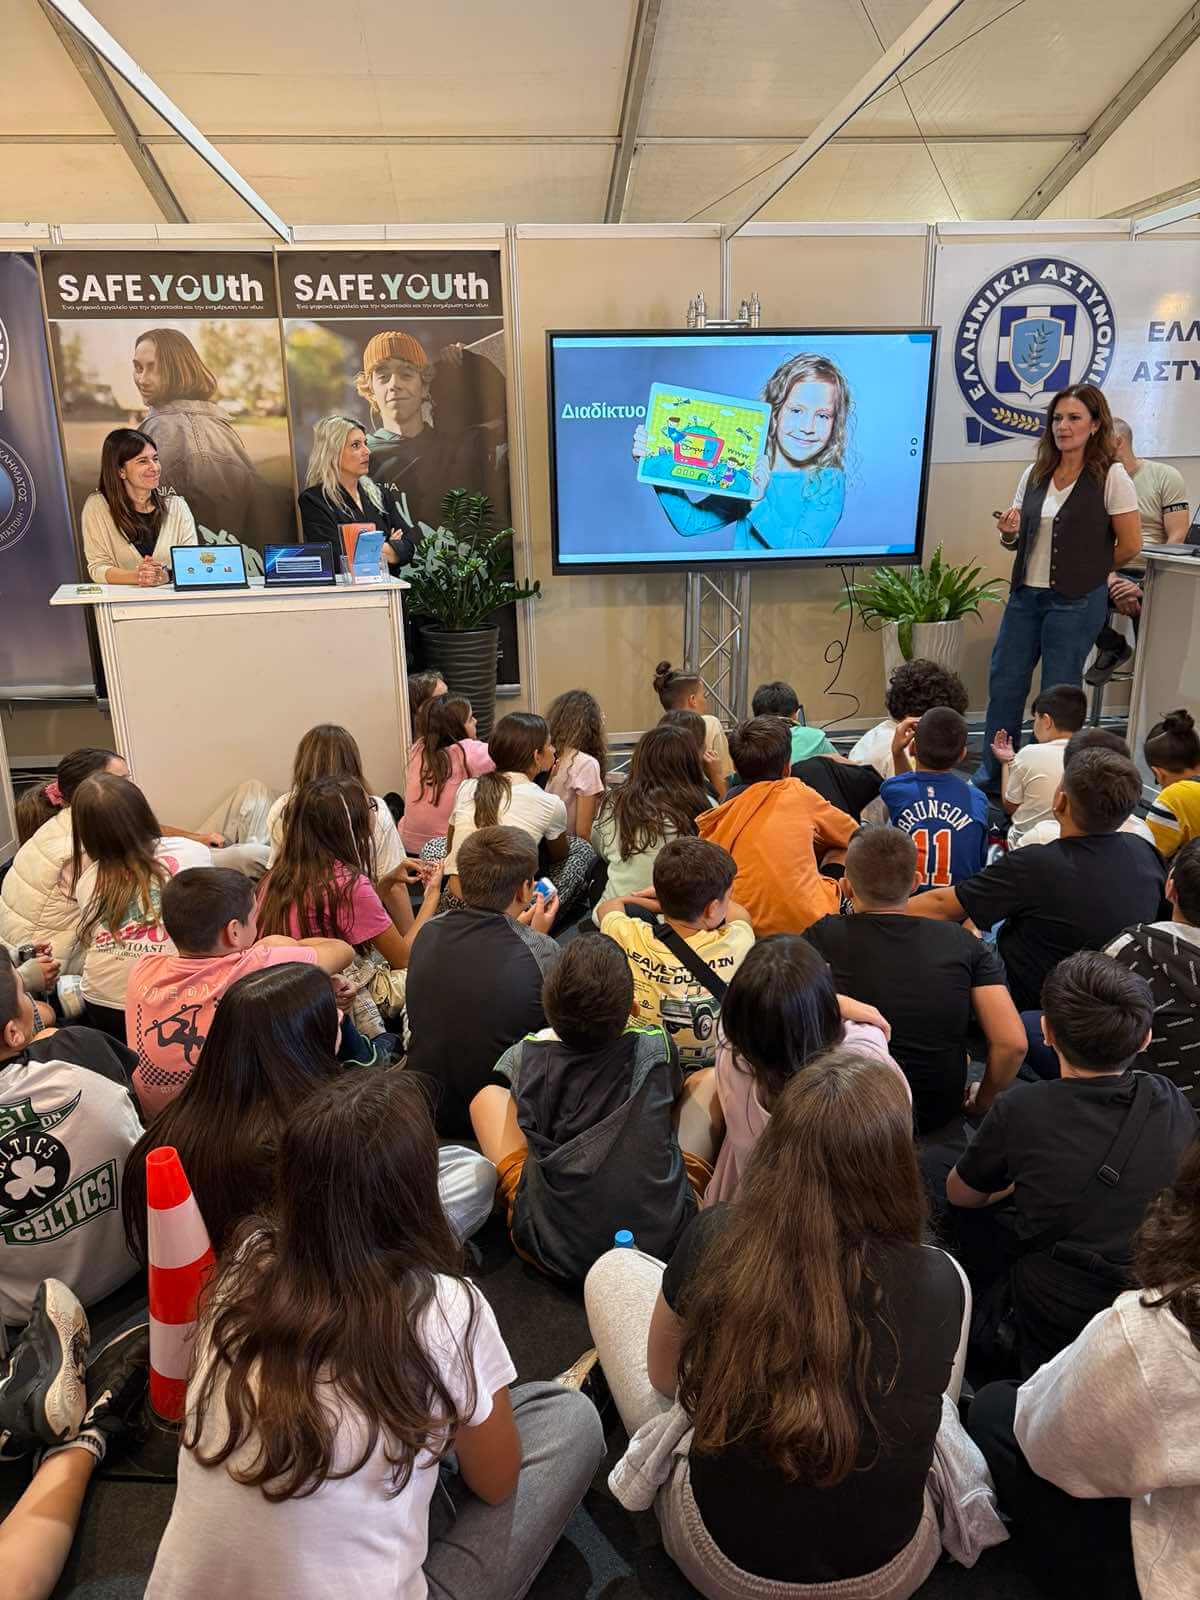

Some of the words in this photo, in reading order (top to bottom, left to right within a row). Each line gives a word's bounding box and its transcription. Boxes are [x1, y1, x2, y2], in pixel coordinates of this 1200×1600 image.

[58, 273, 264, 302] SAFE.YOUth
[294, 272, 489, 301] SAFE.YOUth
[961, 266, 1030, 401] ΕΛΛΗΝΙΚΗ
[1040, 264, 1112, 384] ΑΣΤΥΝΟΜΙ
[561, 402, 647, 419] Διαδίκτυο
[898, 800, 973, 833] BRUNSON
[912, 829, 952, 887] 11
[640, 967, 671, 984] THE
[13, 1168, 113, 1241] CELTICS
